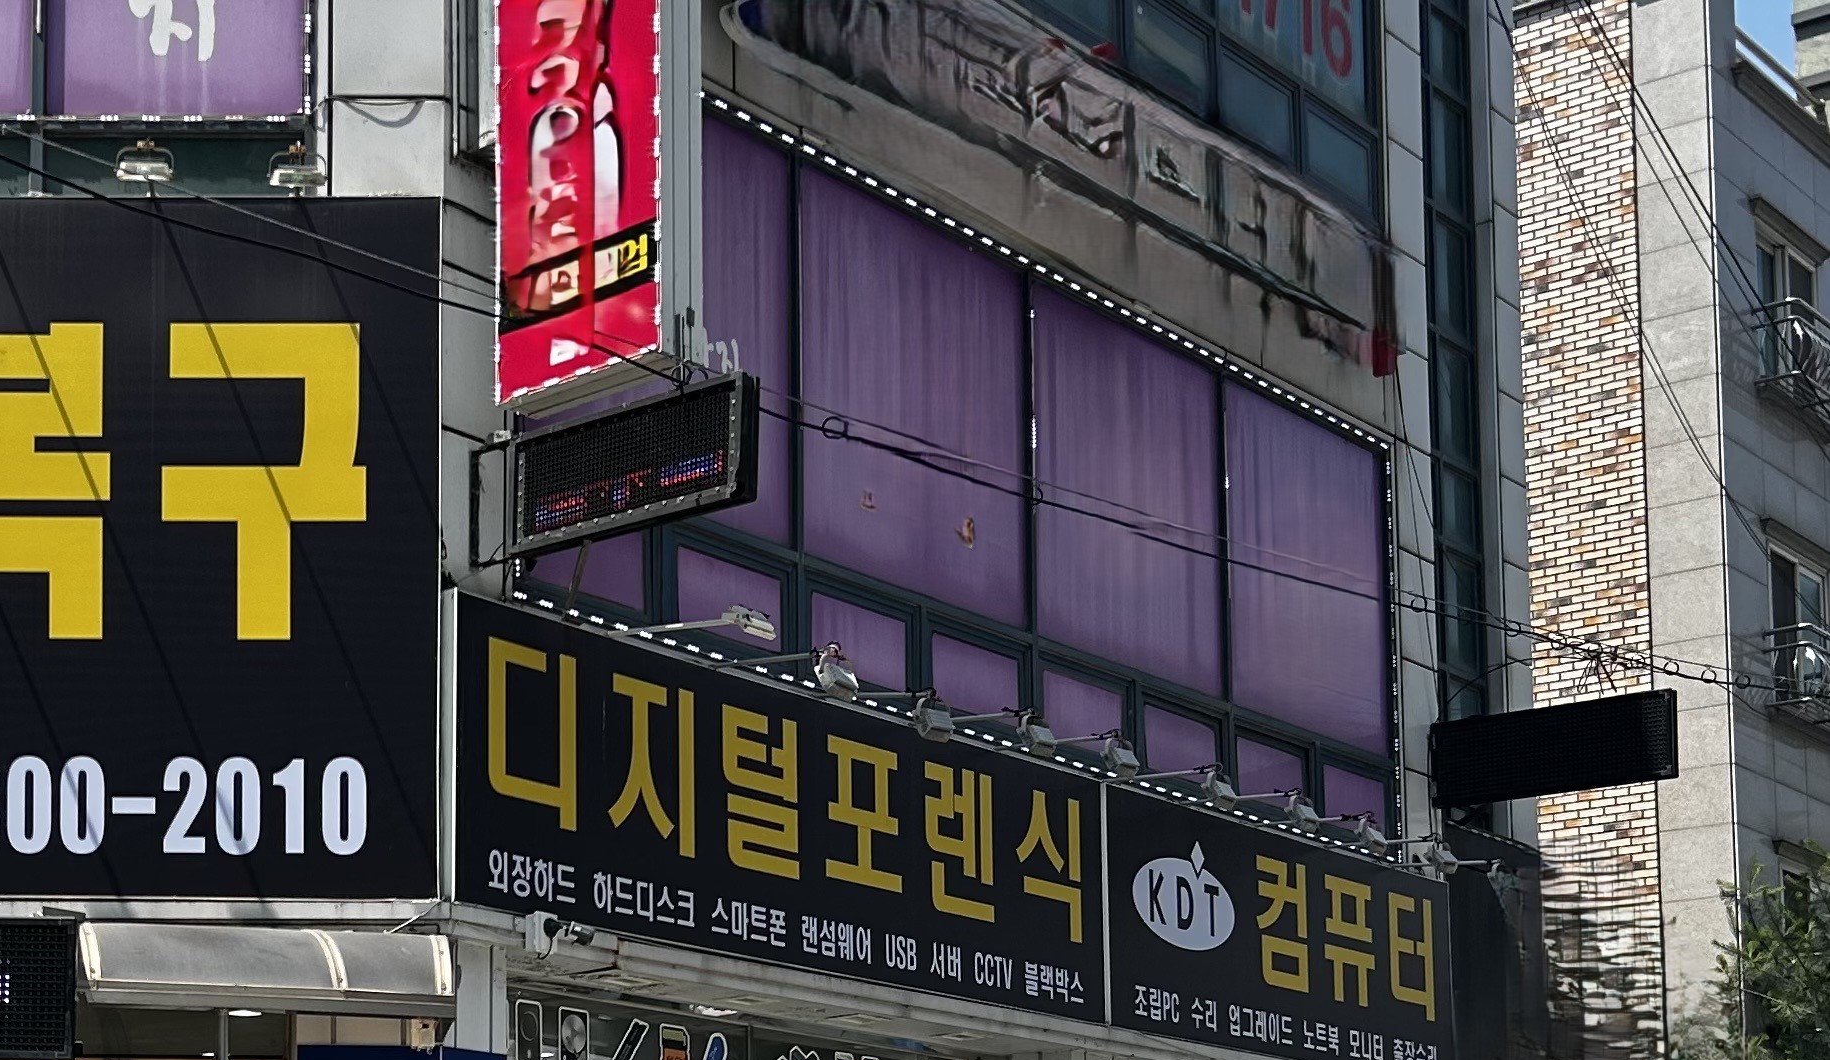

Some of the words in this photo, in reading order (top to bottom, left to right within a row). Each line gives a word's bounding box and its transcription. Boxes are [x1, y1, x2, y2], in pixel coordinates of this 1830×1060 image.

[487, 636, 1083, 944] 디지털포렌식
[487, 849, 576, 905] 외장하드
[593, 870, 695, 929] 하드디스크
[710, 905, 787, 949] 스마트폰
[801, 915, 872, 966] 랜섬웨어
[885, 934, 918, 973] USB
[929, 941, 963, 983] 서버
[974, 951, 1013, 990] CCTV
[1024, 961, 1085, 1005] 블랙박스
[1148, 868, 1220, 937] KDT
[1255, 854, 1436, 1022] 컴퓨터
[1134, 984, 1180, 1024] 조립PC
[1191, 996, 1218, 1033] 수리
[1228, 1003, 1293, 1046] 업그레이드
[1303, 1019, 1340, 1056] 노트북
